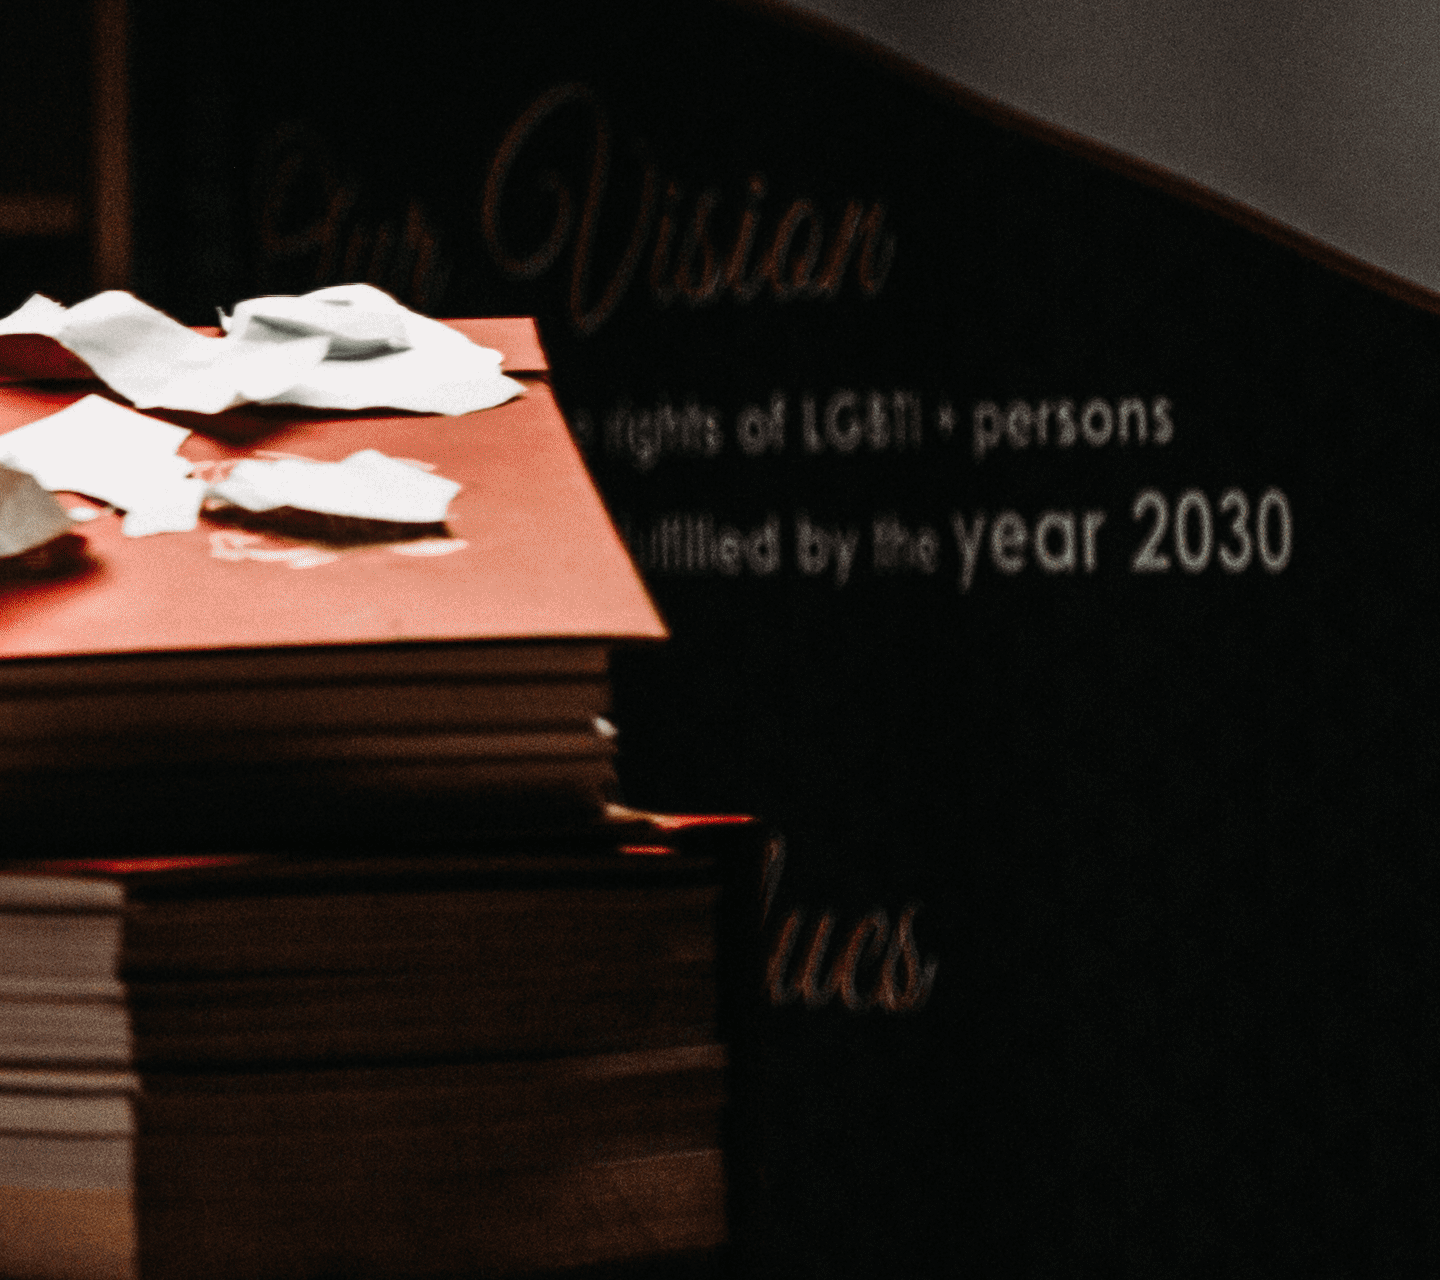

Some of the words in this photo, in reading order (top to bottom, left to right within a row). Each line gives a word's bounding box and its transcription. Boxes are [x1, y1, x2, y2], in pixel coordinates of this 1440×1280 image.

[479, 80, 898, 336] Vision
[604, 395, 724, 473] rights
[737, 387, 787, 457] of
[973, 392, 1175, 461] persons
[796, 508, 862, 588] by
[871, 509, 943, 576] the
[953, 506, 1106, 596] year
[1130, 487, 1294, 576] 2030
